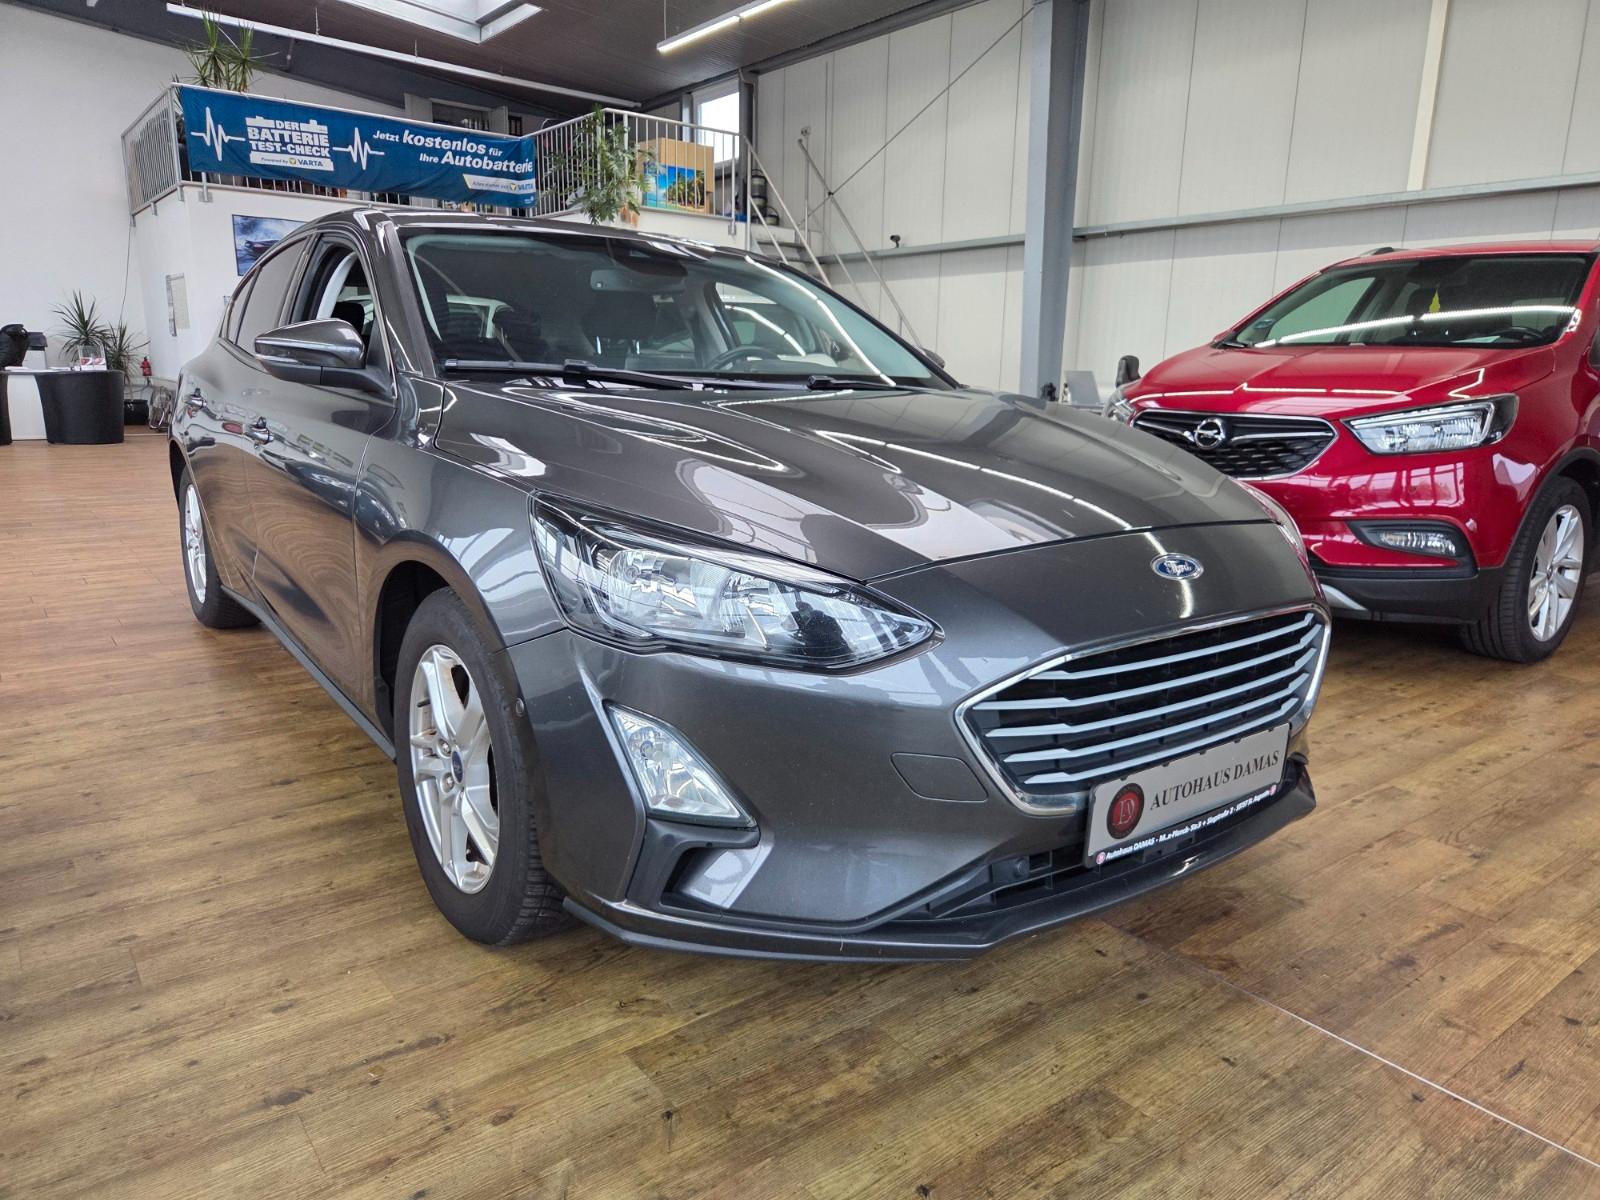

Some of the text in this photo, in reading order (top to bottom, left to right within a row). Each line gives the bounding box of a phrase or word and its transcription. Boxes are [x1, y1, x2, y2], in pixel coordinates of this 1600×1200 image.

[275, 120, 299, 130] DER
[247, 127, 329, 147] BATTERIE
[373, 130, 502, 156] Jetzt kostenlos für
[249, 141, 330, 157] TEST-CHECK
[297, 159, 323, 167] VARTA
[419, 151, 533, 173] Ihre Autobatterie
[1151, 750, 1280, 810] AUTOHAUS DAMAS
[1105, 845, 1133, 861] Autohaus
[1133, 837, 1156, 850] DAMAS
